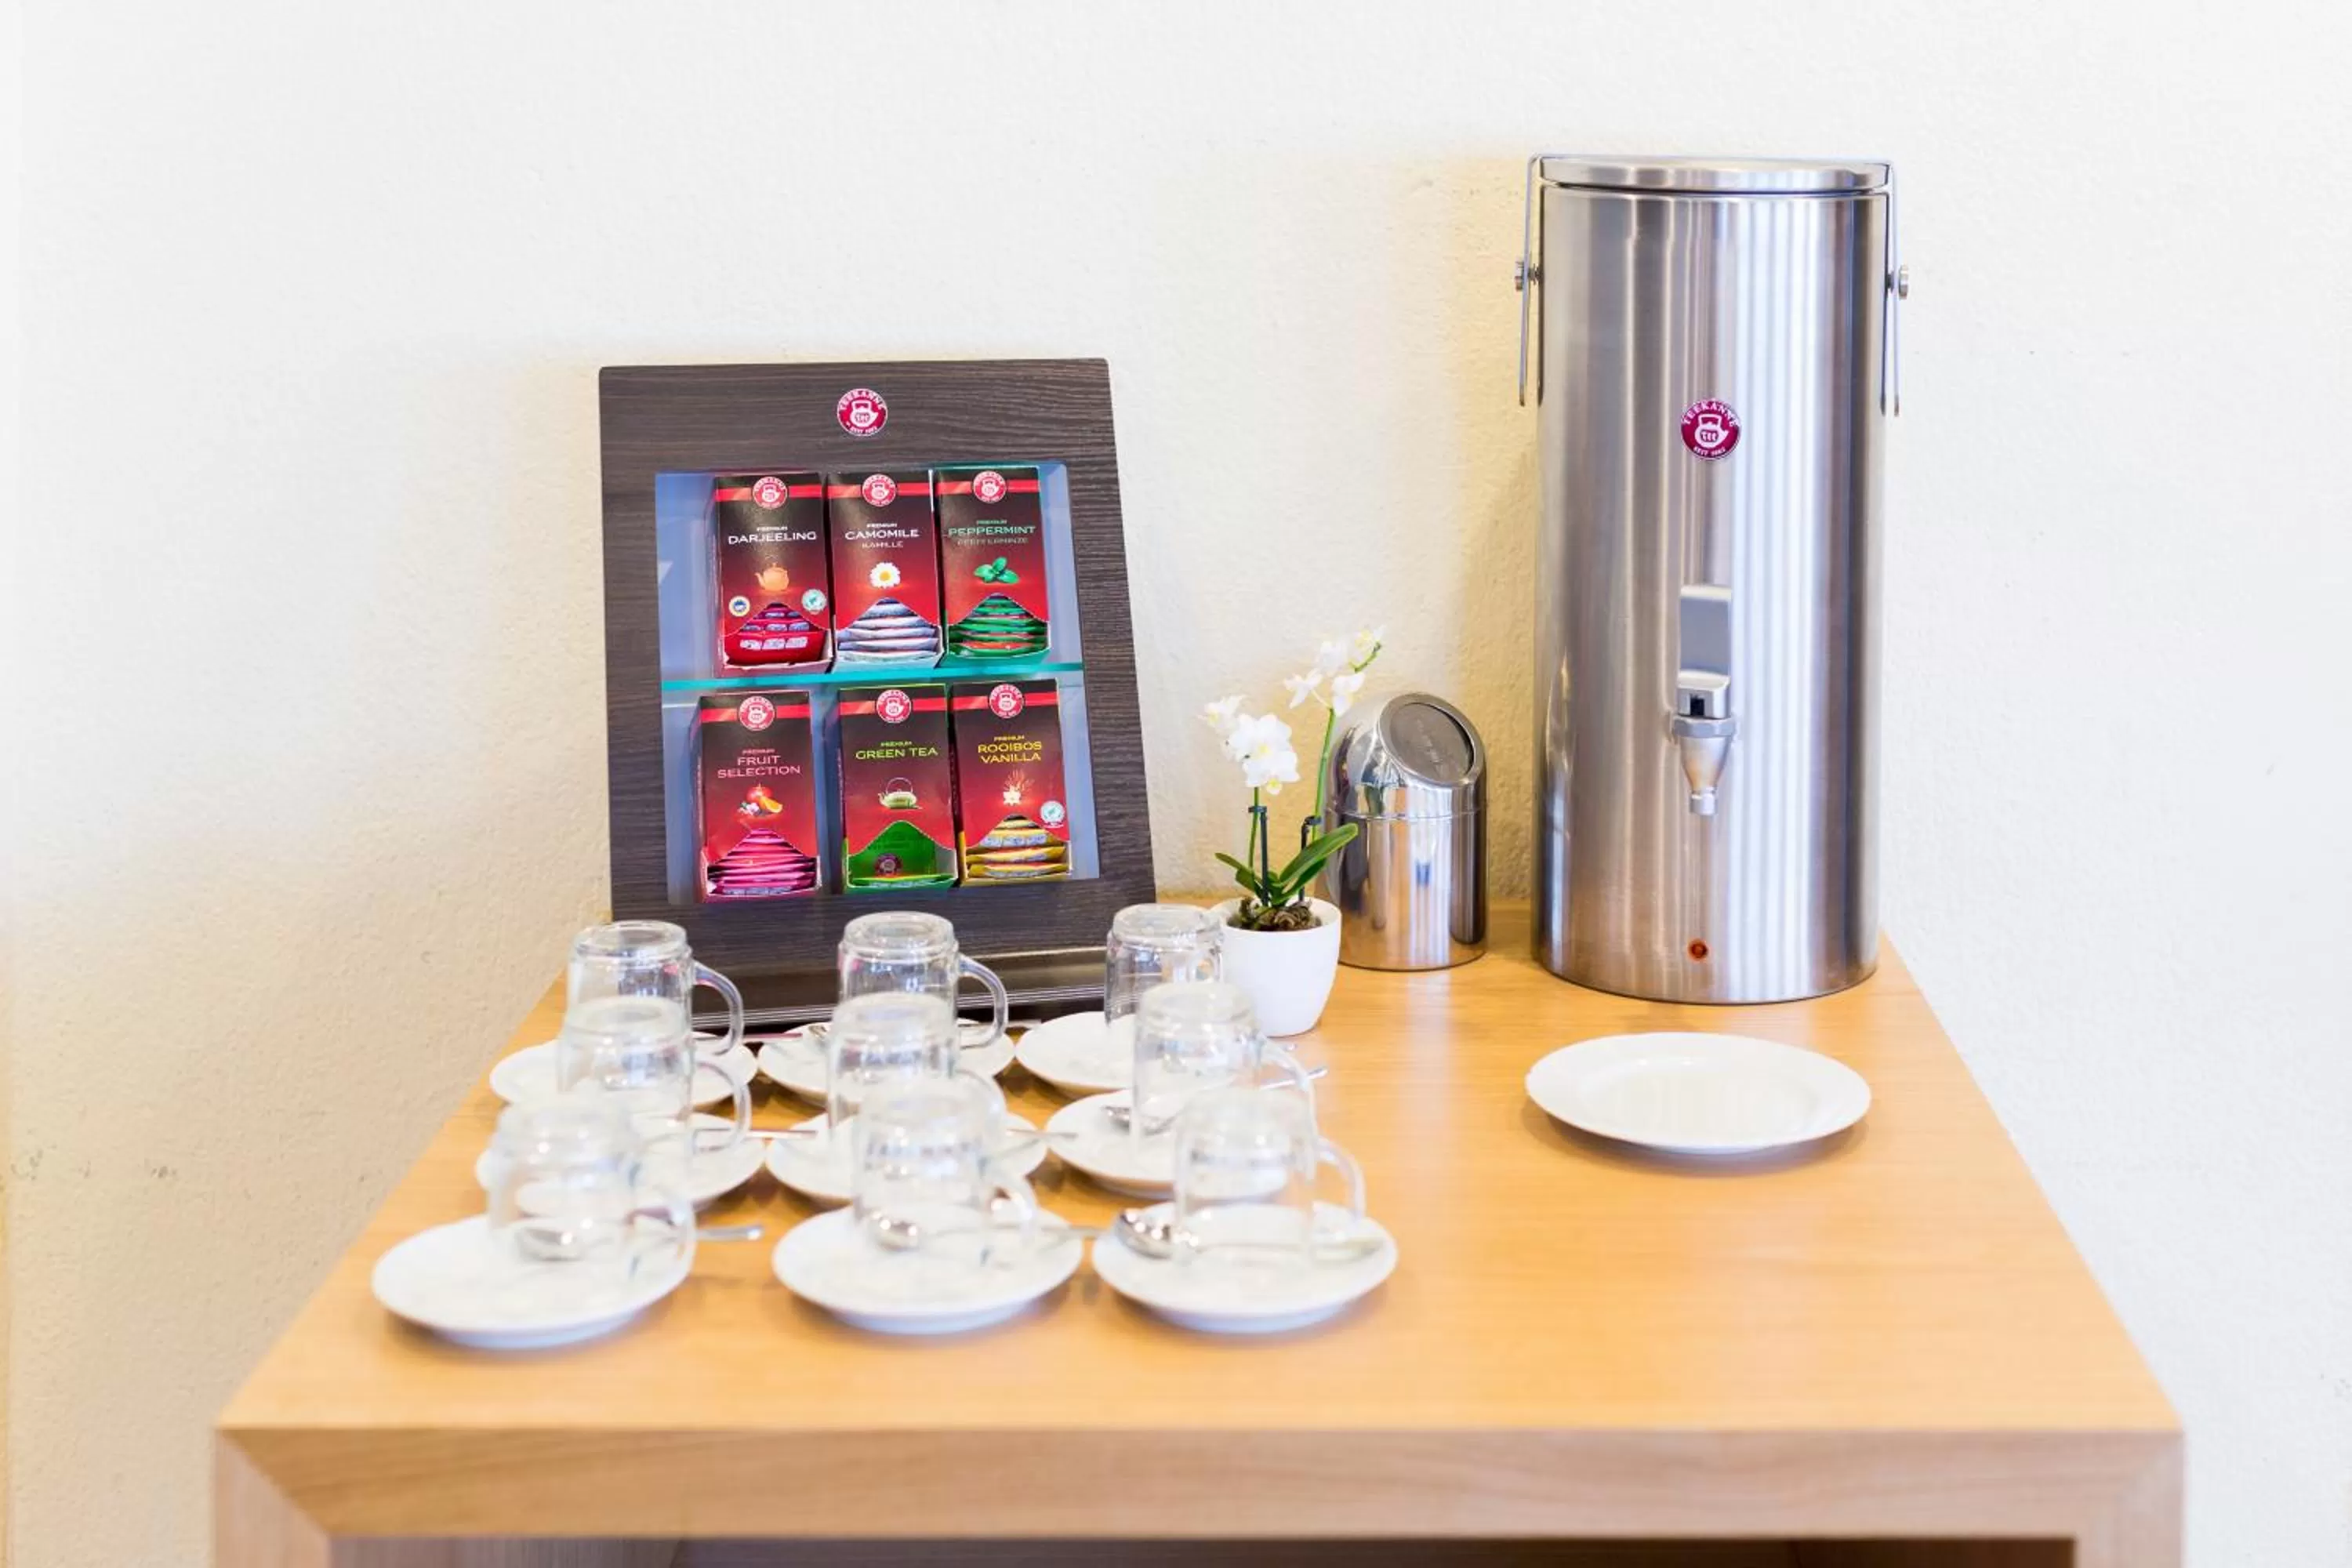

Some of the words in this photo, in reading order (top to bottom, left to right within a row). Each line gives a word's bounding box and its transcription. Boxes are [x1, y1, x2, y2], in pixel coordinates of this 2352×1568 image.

[844, 528, 920, 540] CAMOMILE
[948, 526, 1036, 537] PEPPERMINT
[728, 531, 817, 545] DARJEELING
[855, 748, 906, 760] GREEN
[909, 746, 938, 757] TEA
[978, 741, 1042, 753] ROOIBOS
[737, 755, 781, 766] FRUIT
[980, 752, 1041, 764] VANILLA
[717, 765, 800, 779] SELECTION
